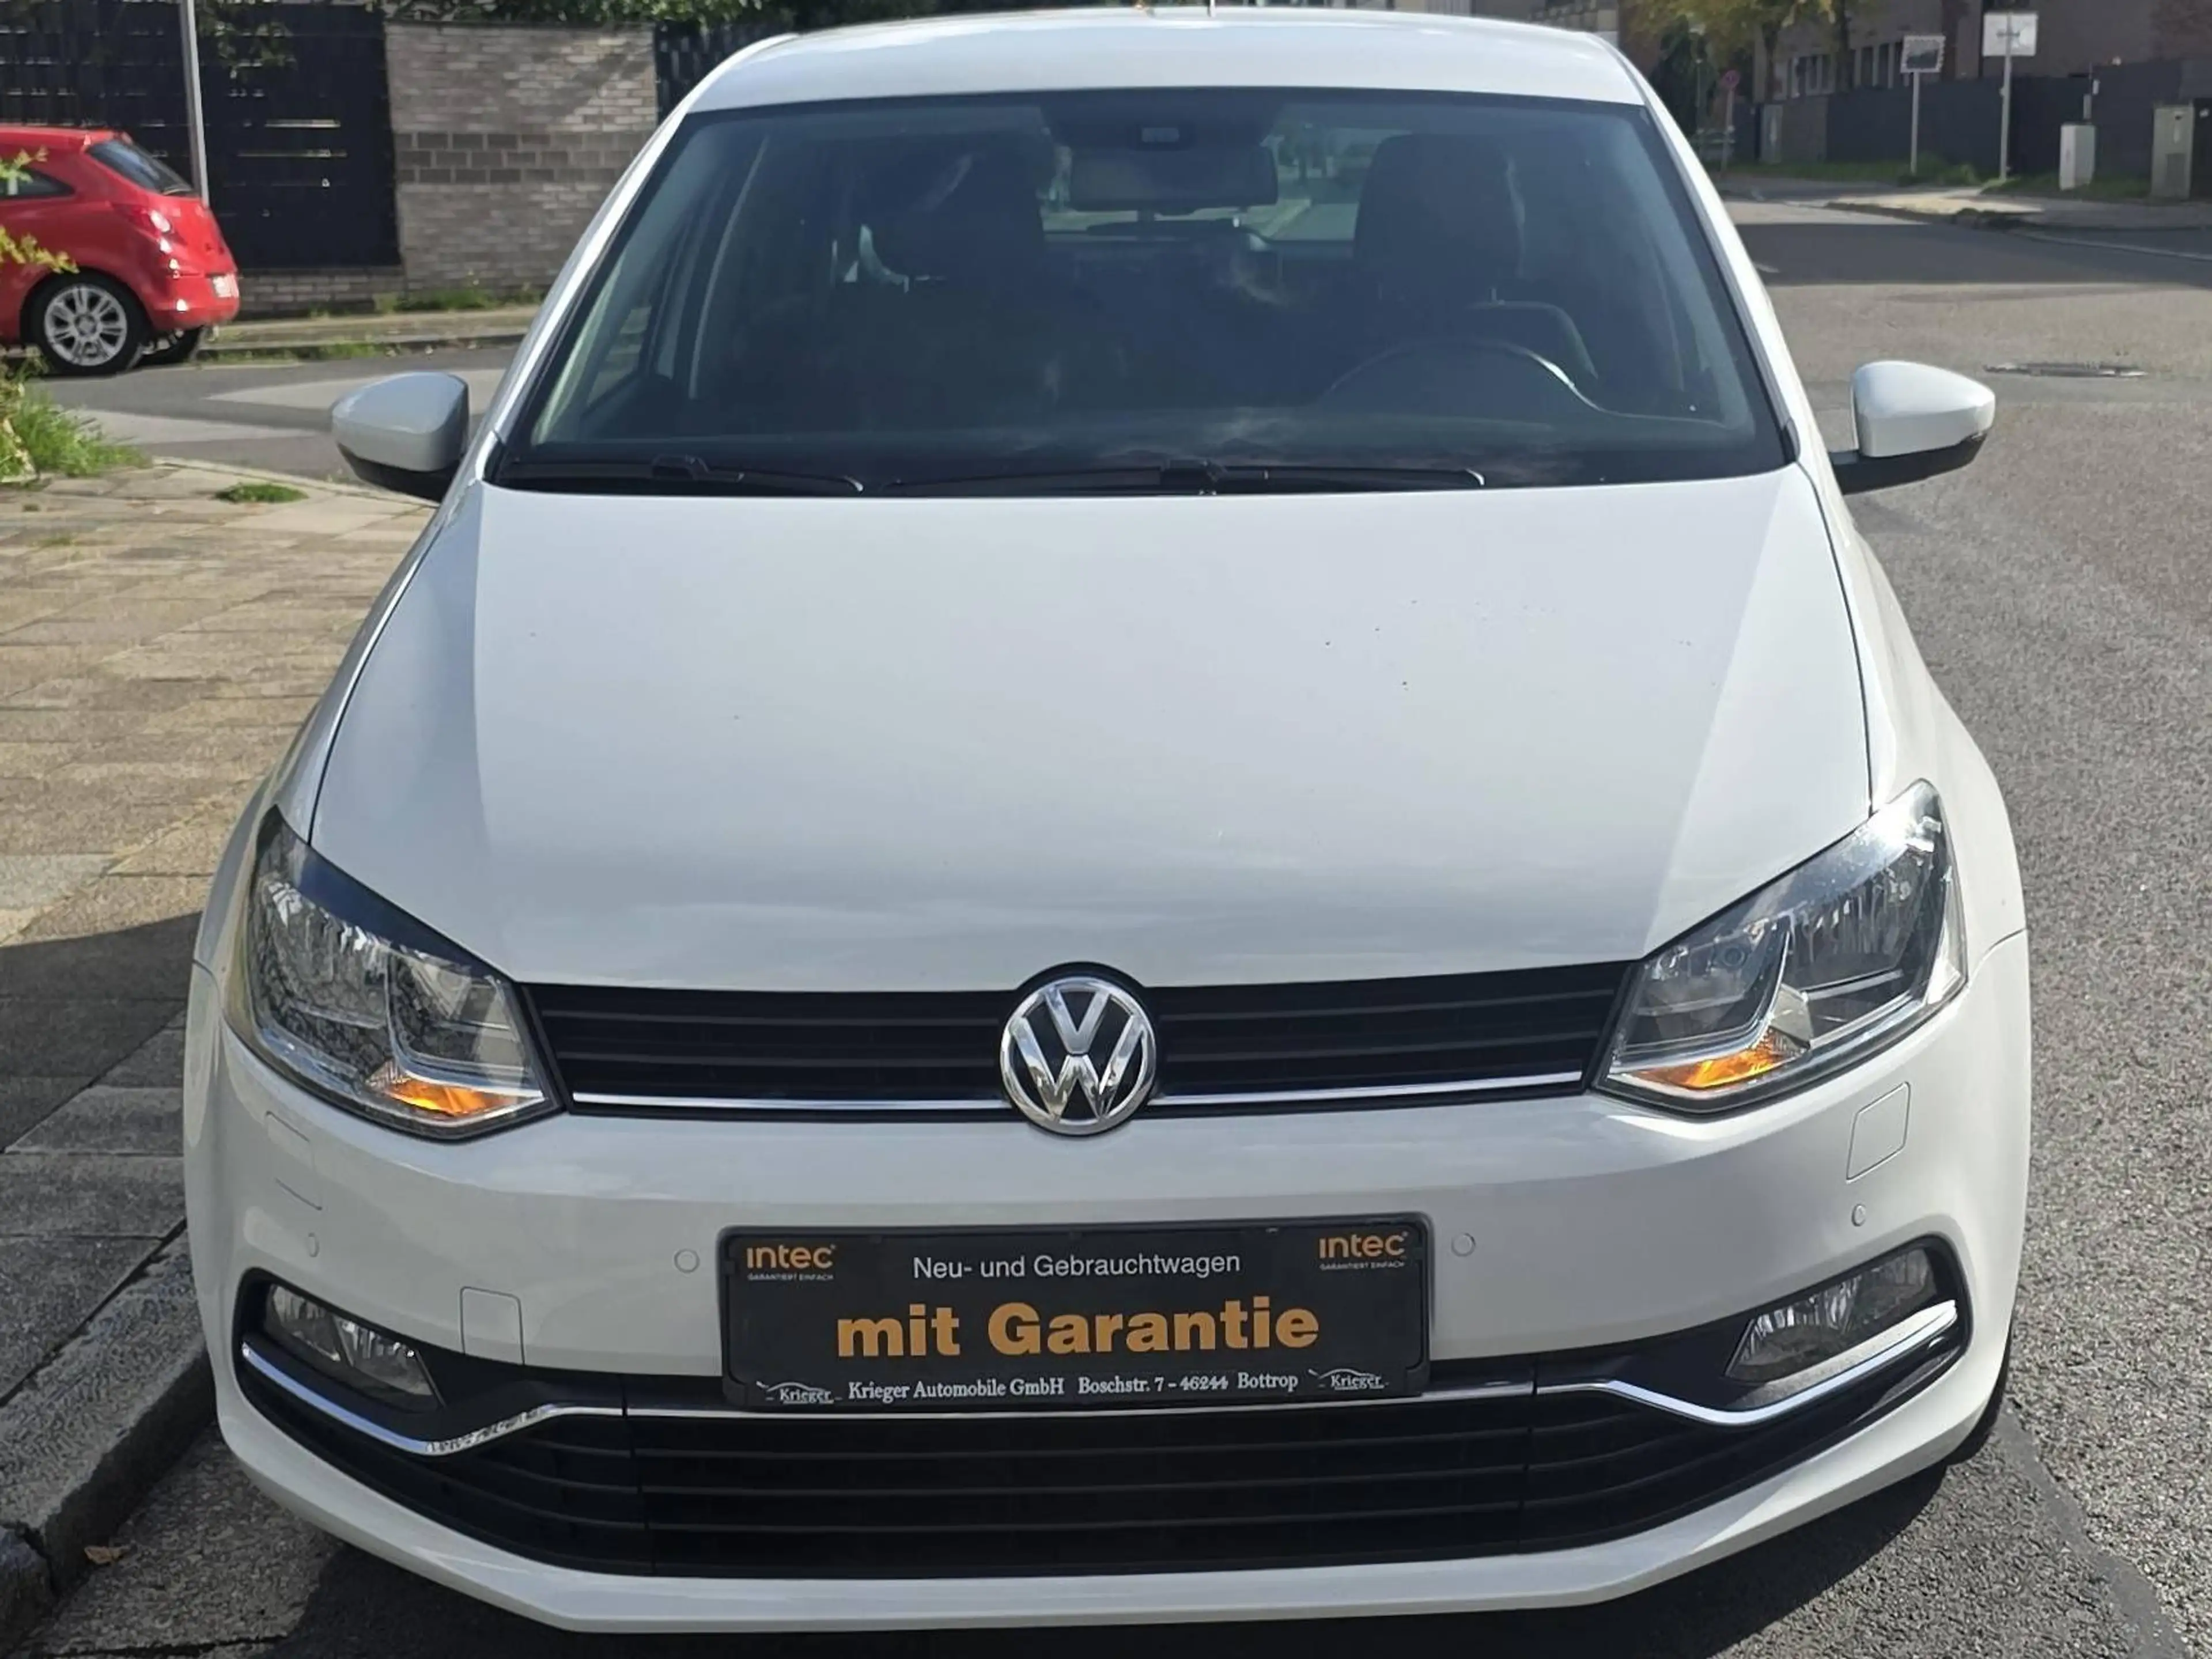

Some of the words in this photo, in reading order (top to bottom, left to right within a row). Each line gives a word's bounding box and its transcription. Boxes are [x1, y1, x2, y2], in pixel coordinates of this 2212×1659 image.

[747, 1244, 833, 1268] intec
[1319, 1234, 1405, 1259] intec
[913, 1257, 972, 1278] Neu-
[980, 1255, 1025, 1277] und
[1034, 1253, 1240, 1278] Gebrauchtwagen
[837, 1303, 961, 1357] mit
[988, 1296, 1319, 1355] Garantie
[848, 1381, 910, 1404] Krieger
[913, 1379, 1007, 1399] Automobile
[1009, 1377, 1065, 1396] GmbH
[1077, 1375, 1151, 1394] Boschstr.
[1154, 1377, 1164, 1392] 7
[1179, 1375, 1228, 1391] 46244
[1238, 1371, 1298, 1393] Bottrop
[1330, 1374, 1385, 1391] Krieger
[780, 1388, 834, 1404] Krieger
